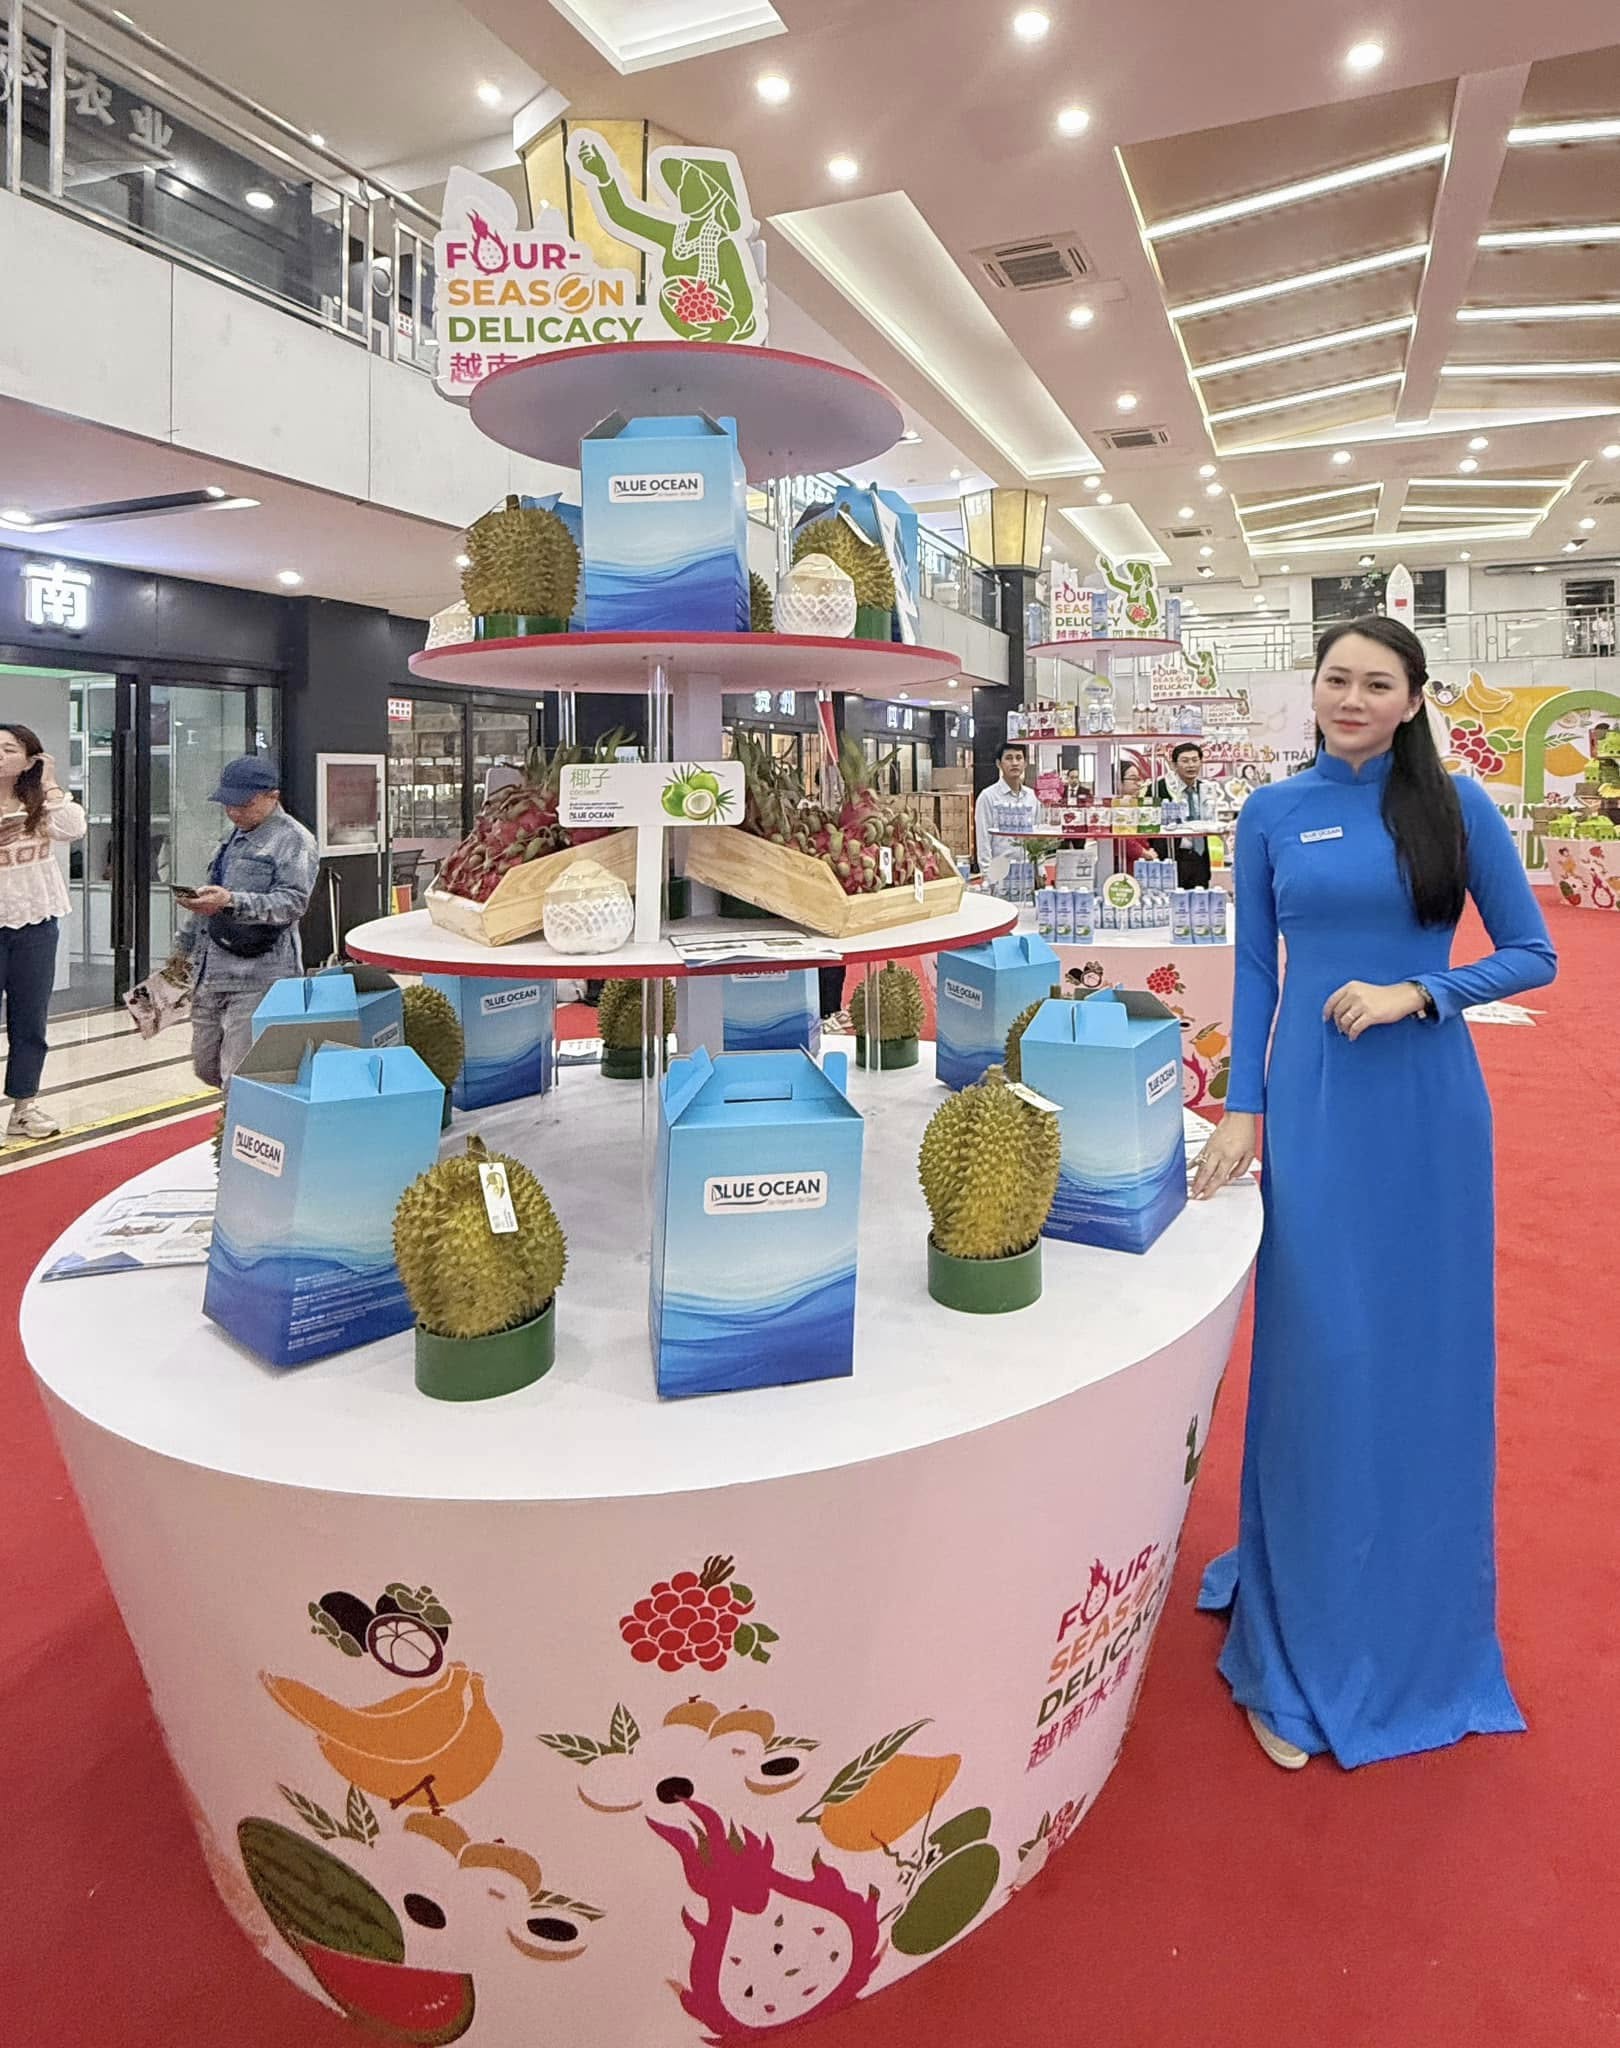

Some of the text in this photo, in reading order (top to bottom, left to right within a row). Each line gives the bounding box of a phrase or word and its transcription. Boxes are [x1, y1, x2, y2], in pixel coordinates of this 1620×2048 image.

[448, 317, 643, 343] DELICACY
[615, 478, 698, 493] BLUE OCEAN
[21, 561, 91, 630] 南
[1056, 604, 1115, 615] SEASN
[569, 768, 611, 788] 椰子
[588, 811, 614, 819] OCEAN
[484, 988, 537, 1008] BLUE OCEAN
[959, 987, 981, 1002] OCEAN
[235, 1131, 282, 1163] BLUE OCEAN
[711, 1182, 755, 1202] BLUE
[758, 1178, 821, 1197] OCEAN
